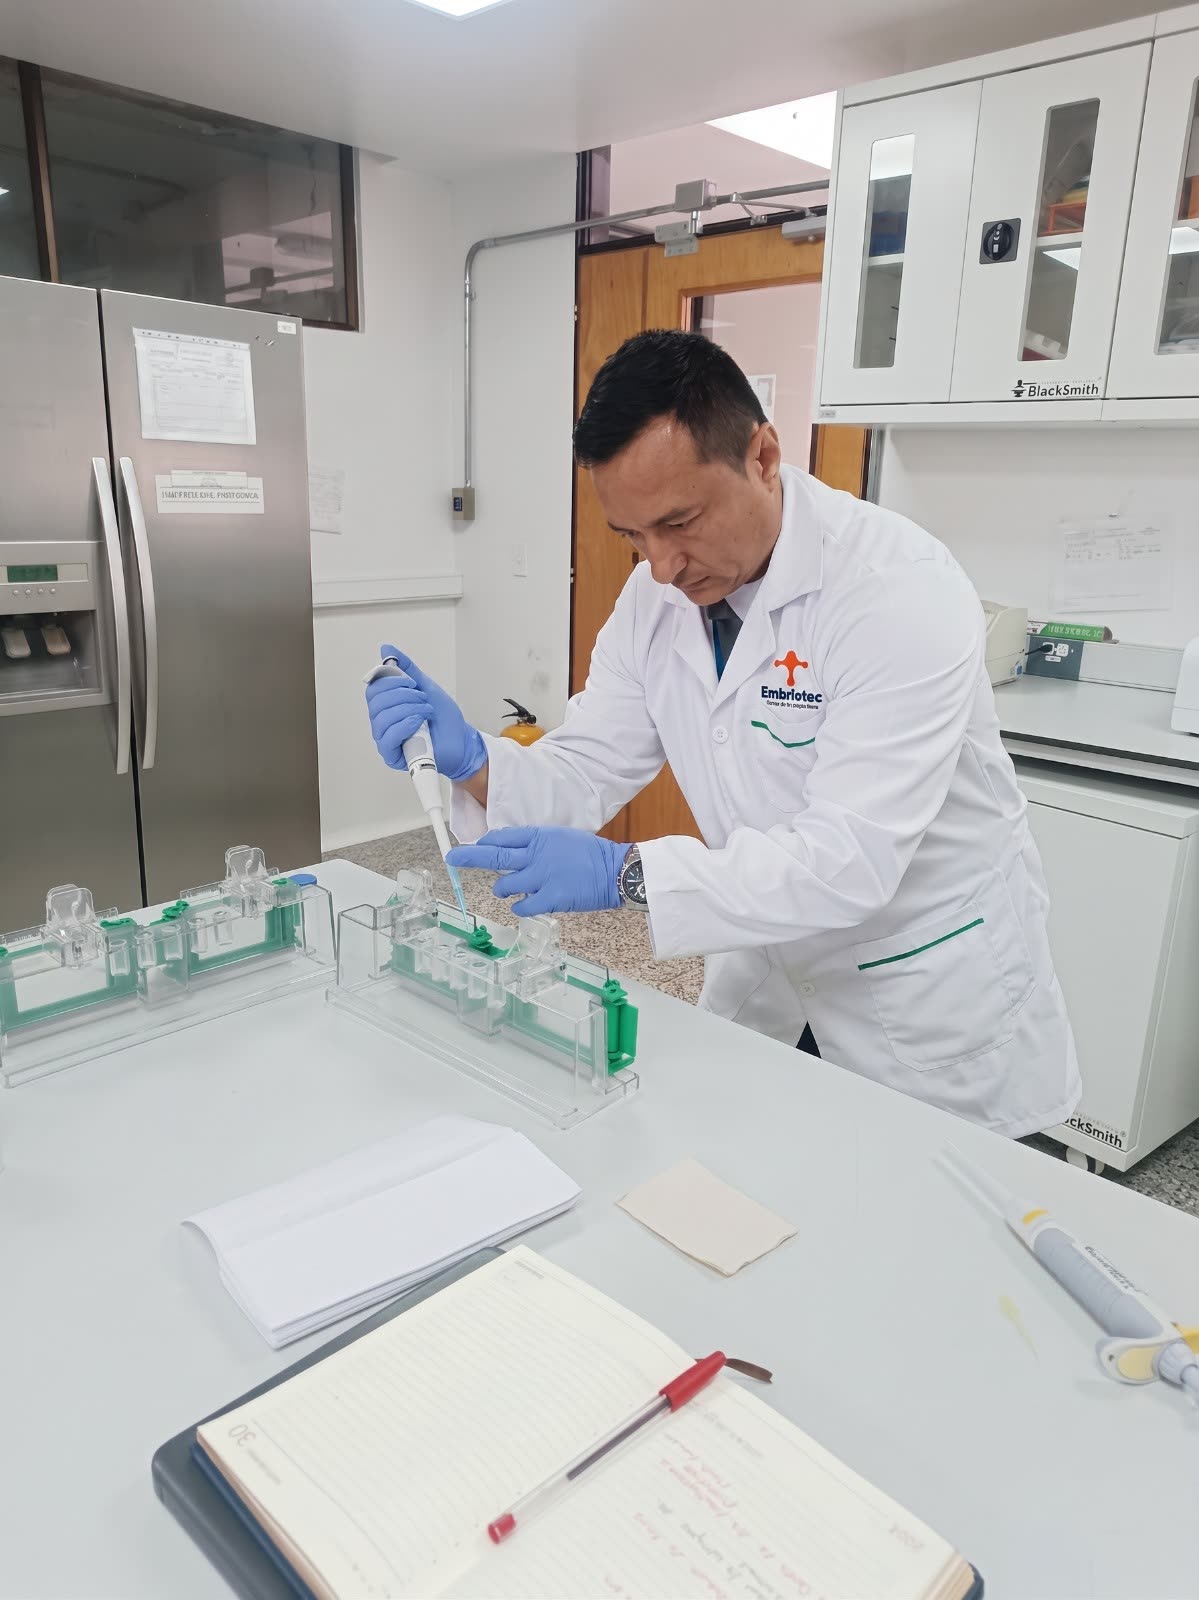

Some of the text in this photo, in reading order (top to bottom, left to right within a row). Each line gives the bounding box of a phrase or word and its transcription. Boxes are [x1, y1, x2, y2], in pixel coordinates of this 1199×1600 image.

[1028, 384, 1099, 397] BlackSmith
[761, 685, 823, 703] Embriotec
[1065, 1117, 1122, 1148] ckSmith
